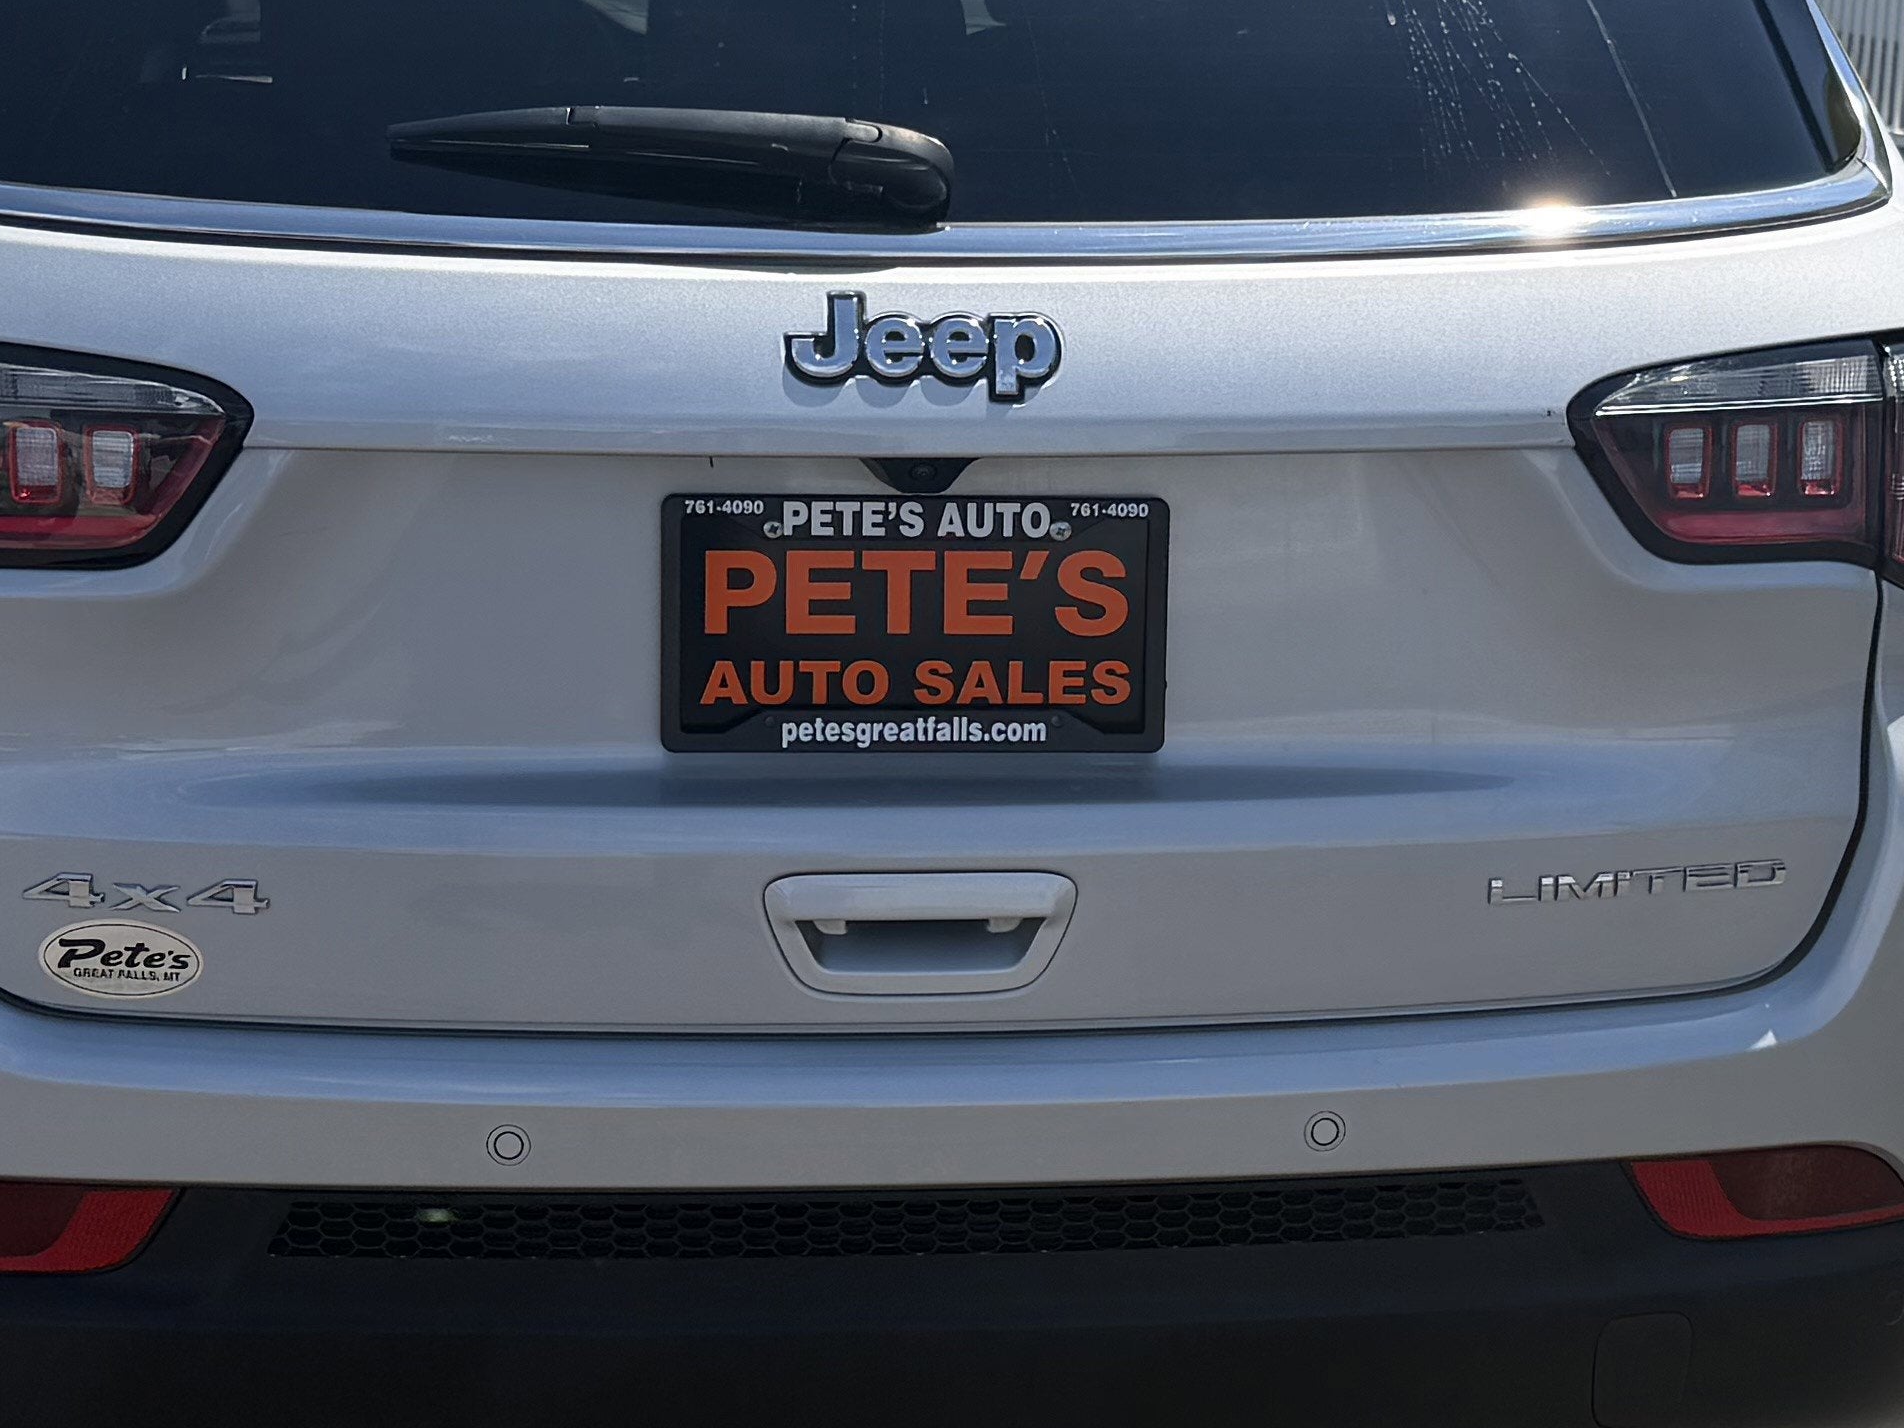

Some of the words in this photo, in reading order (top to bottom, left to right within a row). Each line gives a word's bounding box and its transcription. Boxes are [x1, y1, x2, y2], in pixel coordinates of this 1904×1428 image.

[783, 289, 1063, 403] Jeep
[783, 500, 925, 537] PETE'S
[937, 501, 1052, 539] AUTO
[704, 549, 1129, 637] PETE'S
[700, 659, 890, 705] AUTO
[914, 659, 1132, 705] SALES
[781, 716, 1047, 749] petesgreatfalls.com
[22, 872, 271, 916] 4x4
[1487, 858, 1786, 906] LIMITED
[57, 938, 192, 971] Pete's
[73, 967, 114, 980] GREAT
